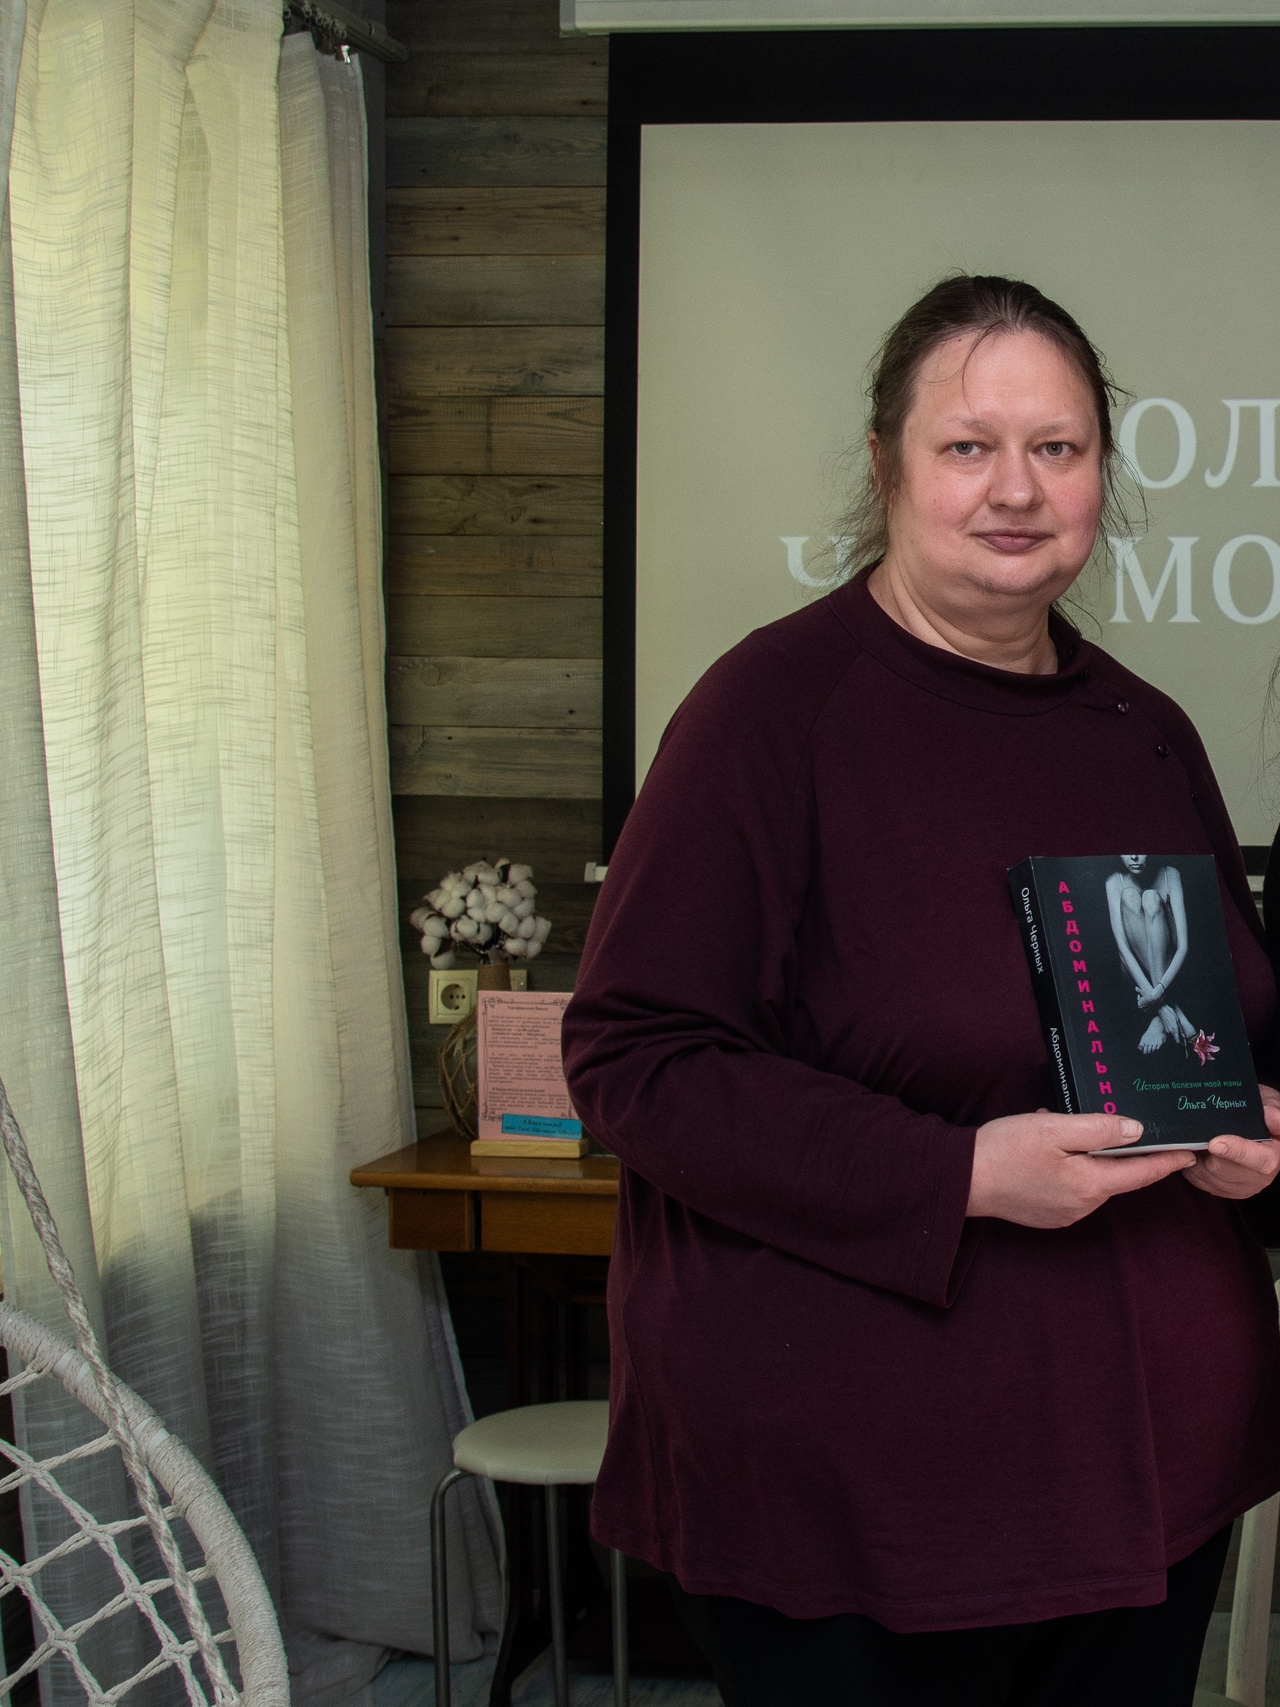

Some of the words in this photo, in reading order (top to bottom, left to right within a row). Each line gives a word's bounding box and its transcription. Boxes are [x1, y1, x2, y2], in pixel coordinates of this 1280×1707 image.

[1021, 887, 1034, 924] Ольга
[1029, 924, 1044, 975] Черных
[1058, 880, 1118, 1115] АБДОМИНАЛЬНО
[1132, 1078, 1171, 1092] История
[1177, 1095, 1207, 1111] Ольга
[1206, 1094, 1247, 1110] Черных
